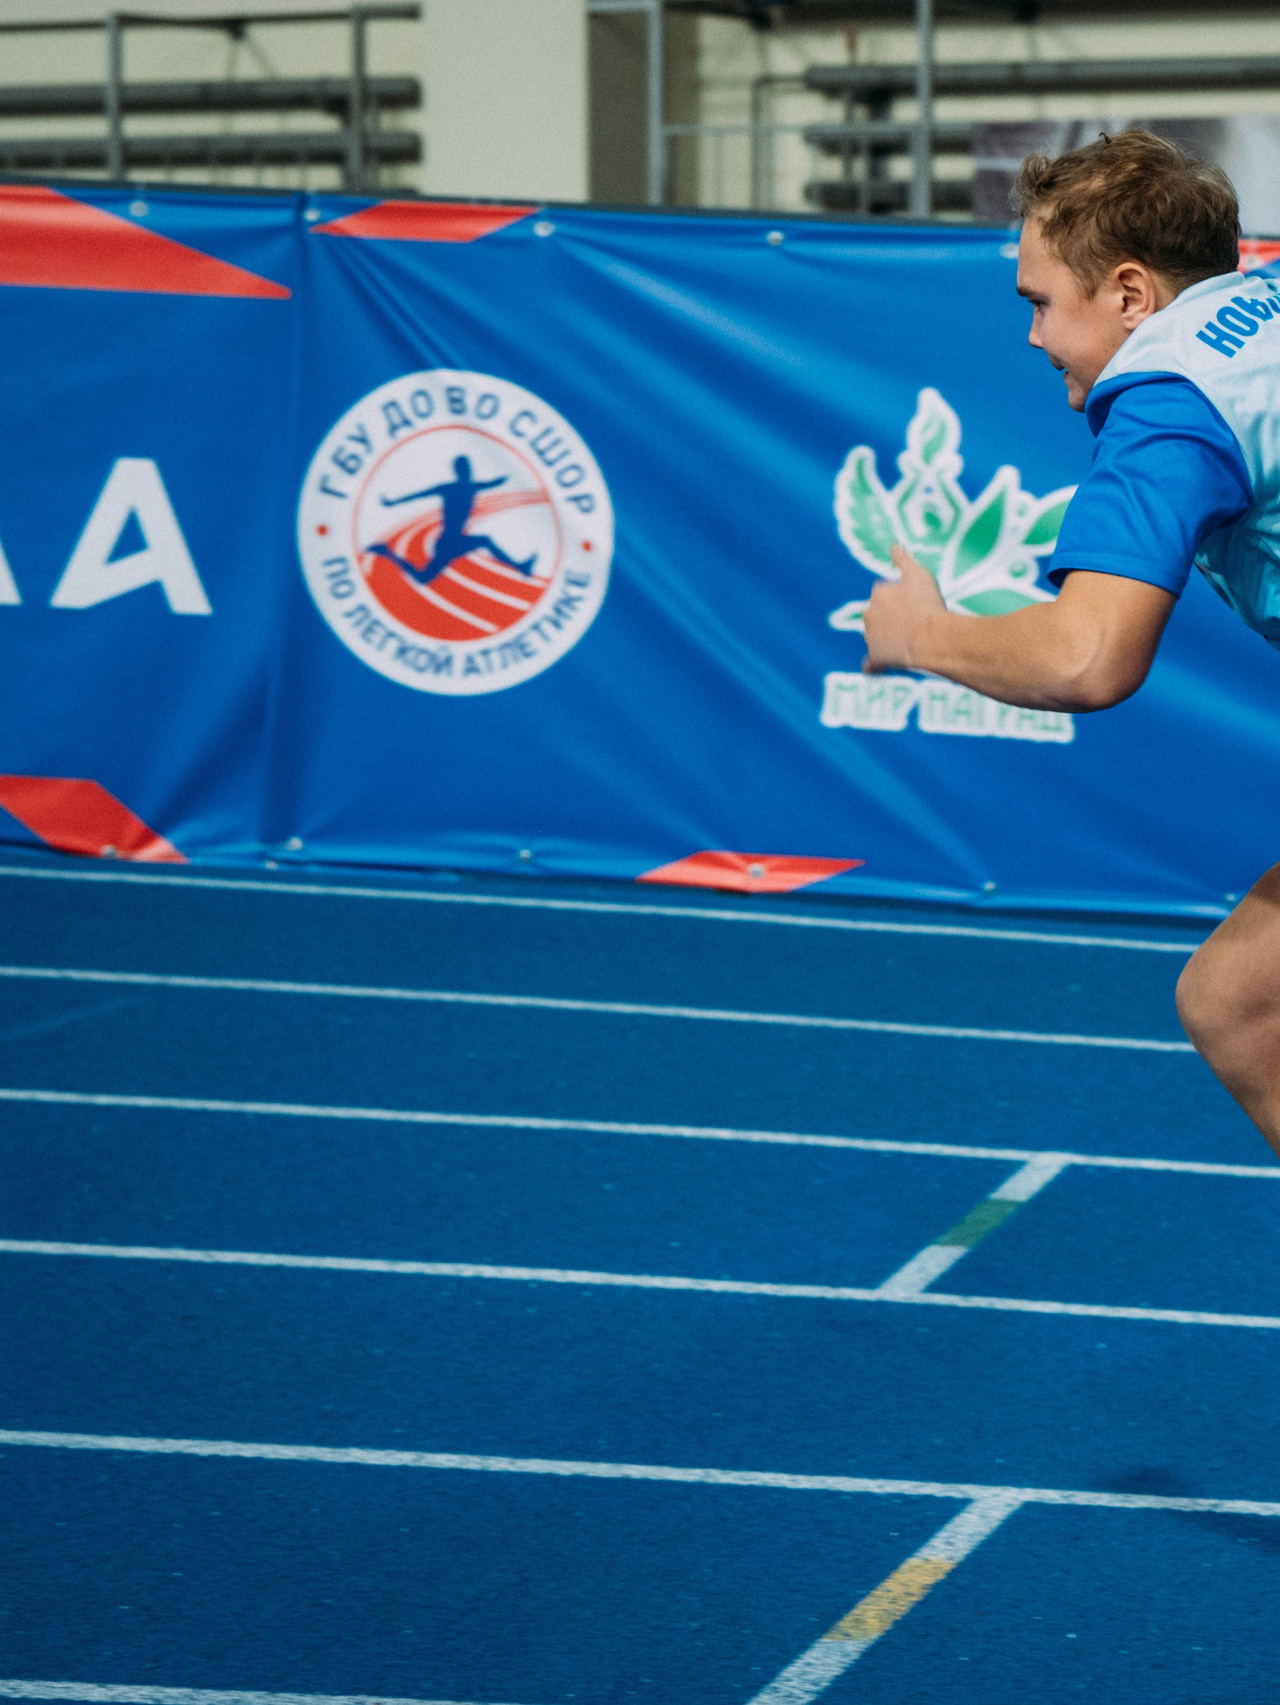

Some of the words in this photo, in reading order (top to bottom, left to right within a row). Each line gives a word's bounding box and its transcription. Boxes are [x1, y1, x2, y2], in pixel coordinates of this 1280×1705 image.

[318, 422, 373, 499] ГБУ
[381, 388, 435, 438] ДО
[446, 385, 500, 420] ВО
[508, 408, 596, 514] СШОР
[321, 556, 356, 600] ПО
[341, 603, 453, 676] ЛЕГКОЙ
[462, 569, 592, 677] АТЛЕТИКЕ
